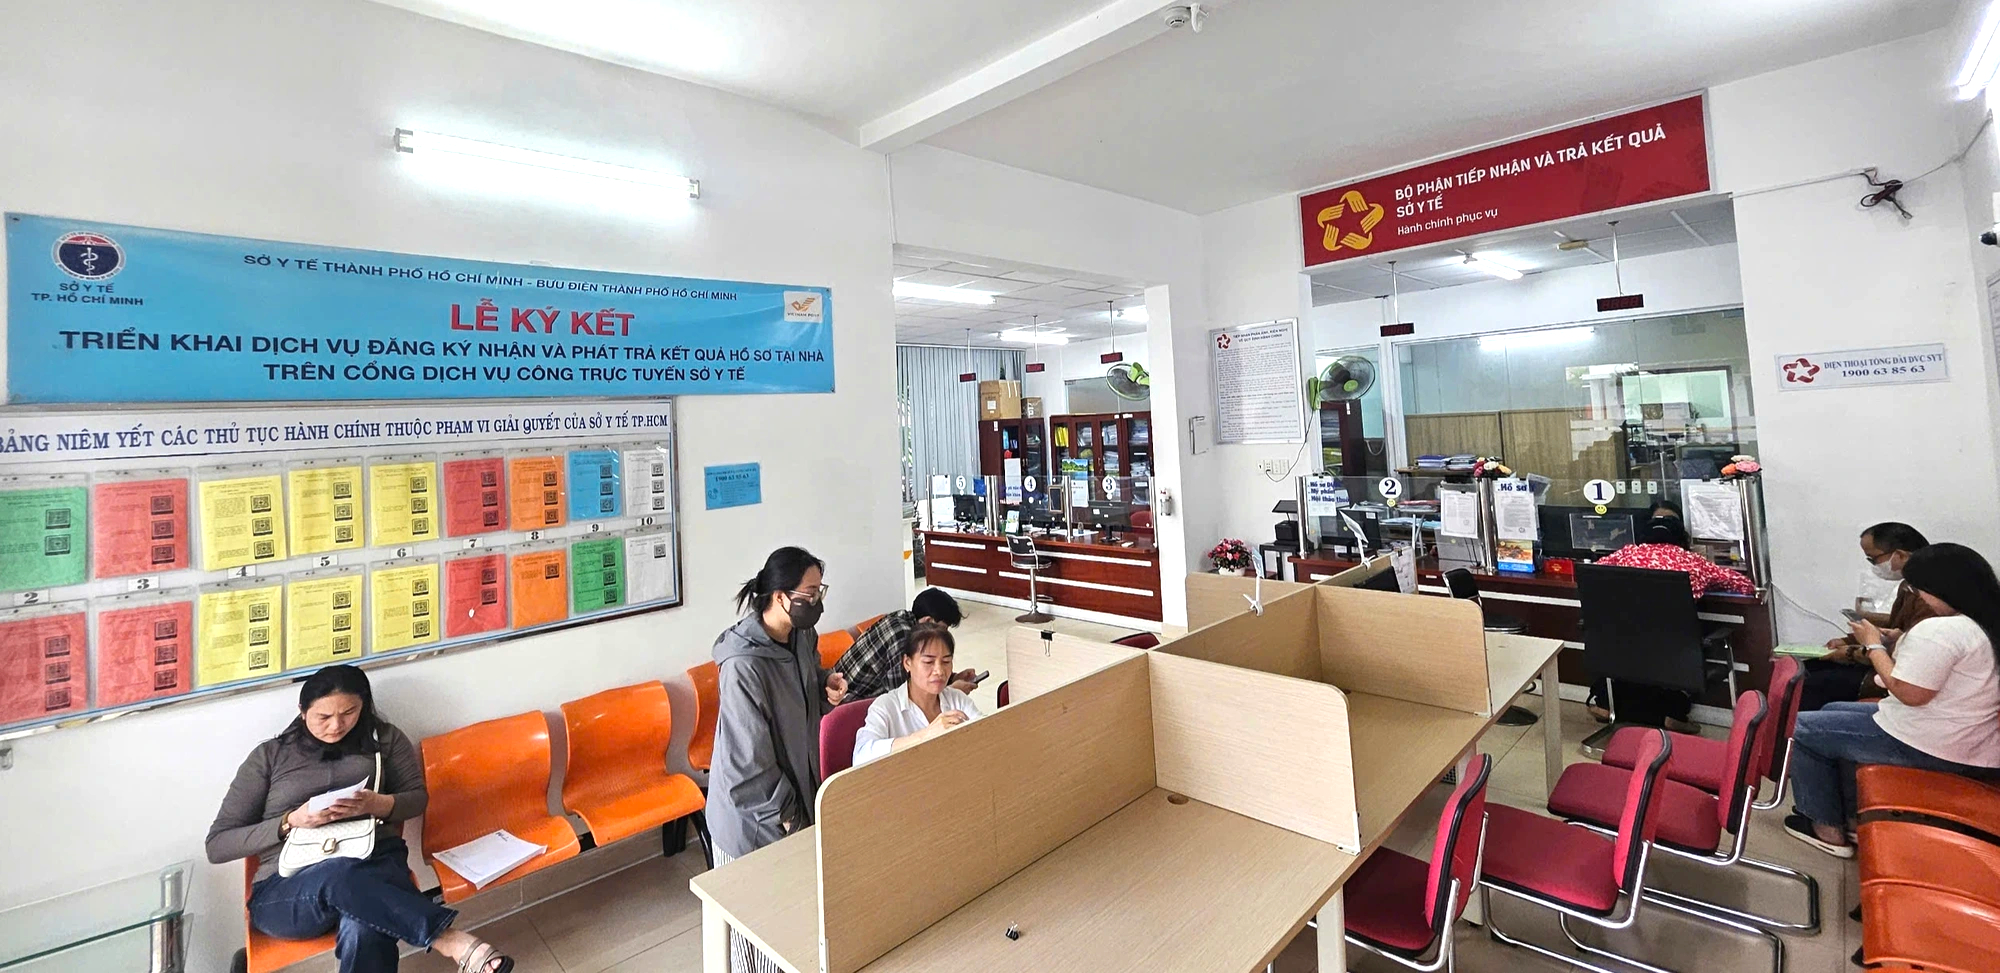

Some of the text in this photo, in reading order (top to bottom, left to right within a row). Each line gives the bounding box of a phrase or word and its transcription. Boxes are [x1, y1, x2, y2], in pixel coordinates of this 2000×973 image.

[1395, 123, 1666, 200] BỘ PHẬN TIẾP NHẬN VÀ TRẢ KẾT QUẢ
[1397, 194, 1443, 217] SỞ Y TẾ
[1398, 209, 1498, 235] Hành chính phục vụ
[244, 254, 271, 266] SỞ
[277, 258, 289, 268] Y
[294, 258, 318, 271] TẾ
[323, 262, 383, 276] THÀNH
[389, 267, 423, 279] PHỐ
[456, 272, 482, 283] CHÍ
[486, 276, 523, 287] MINH
[536, 279, 564, 290] BƯU
[568, 282, 598, 293] ĐIỆN
[602, 283, 642, 295] THÀNH
[645, 286, 669, 297] PHỐ
[690, 289, 708, 299] CHÍ
[712, 291, 737, 300] MINH
[60, 280, 79, 291] SỞ
[97, 282, 115, 293] TẾ
[31, 293, 52, 301] TP.
[81, 295, 105, 303] CHÍ
[109, 297, 143, 305] MINH
[452, 298, 635, 336] LỄ KÝ KẾT
[59, 327, 159, 350] TRIỂN
[171, 334, 241, 352] KHAI
[252, 337, 318, 355] DỊCH
[326, 339, 360, 357] VỤ
[368, 337, 435, 356] ĐĂNG
[443, 339, 472, 357] KÝ
[479, 341, 536, 359] NHẬN
[542, 342, 567, 358] VÀ
[572, 343, 618, 360] PHÁT
[624, 344, 656, 360] TRẢ
[661, 345, 690, 361] KẾT
[694, 346, 725, 361] QUẢ
[754, 349, 772, 362] SƠ
[775, 351, 794, 363] TẠI
[799, 349, 824, 362] NHÀ
[1843, 359, 1867, 368] THOẠI
[1927, 354, 1942, 362] SYT
[263, 360, 746, 383] TRÊN CỔNG DỊCH VỤ CÔNG TRỰC TUYẾN SỞ Y TẾ
[1842, 369, 1869, 377] 1900
[1892, 366, 1906, 374] 85
[1910, 365, 1925, 373] 63
[57, 428, 110, 450] NIÊM
[116, 423, 155, 448] YẾT
[161, 426, 198, 446] CÁC
[204, 422, 239, 444] THỦ
[245, 426, 279, 445] TỤC
[284, 422, 328, 441] HÀNH
[334, 420, 380, 439] CHÍNH
[385, 418, 432, 439] THUỘC
[436, 420, 473, 437] PHẠM
[477, 420, 489, 433] VI
[494, 414, 519, 432] GIẢI
[523, 412, 560, 434] QUYẾT
[565, 412, 587, 429] CỦA
[590, 411, 603, 428] SỞ
[606, 416, 613, 427] Y
[615, 410, 629, 427] TẾ
[631, 415, 668, 427] TP.HCM
[958, 477, 964, 487] 5
[1027, 479, 1033, 489] 4
[1106, 478, 1112, 490] 3
[1384, 480, 1396, 495] 2
[1592, 482, 1606, 500] 1
[642, 517, 653, 525] 10
[592, 524, 599, 532] 9
[531, 531, 539, 540] 8
[469, 538, 477, 548] 7
[397, 548, 406, 558] 6
[320, 556, 330, 566] 5
[236, 566, 247, 576] 4
[137, 579, 150, 589] 3
[24, 592, 39, 604] 2
